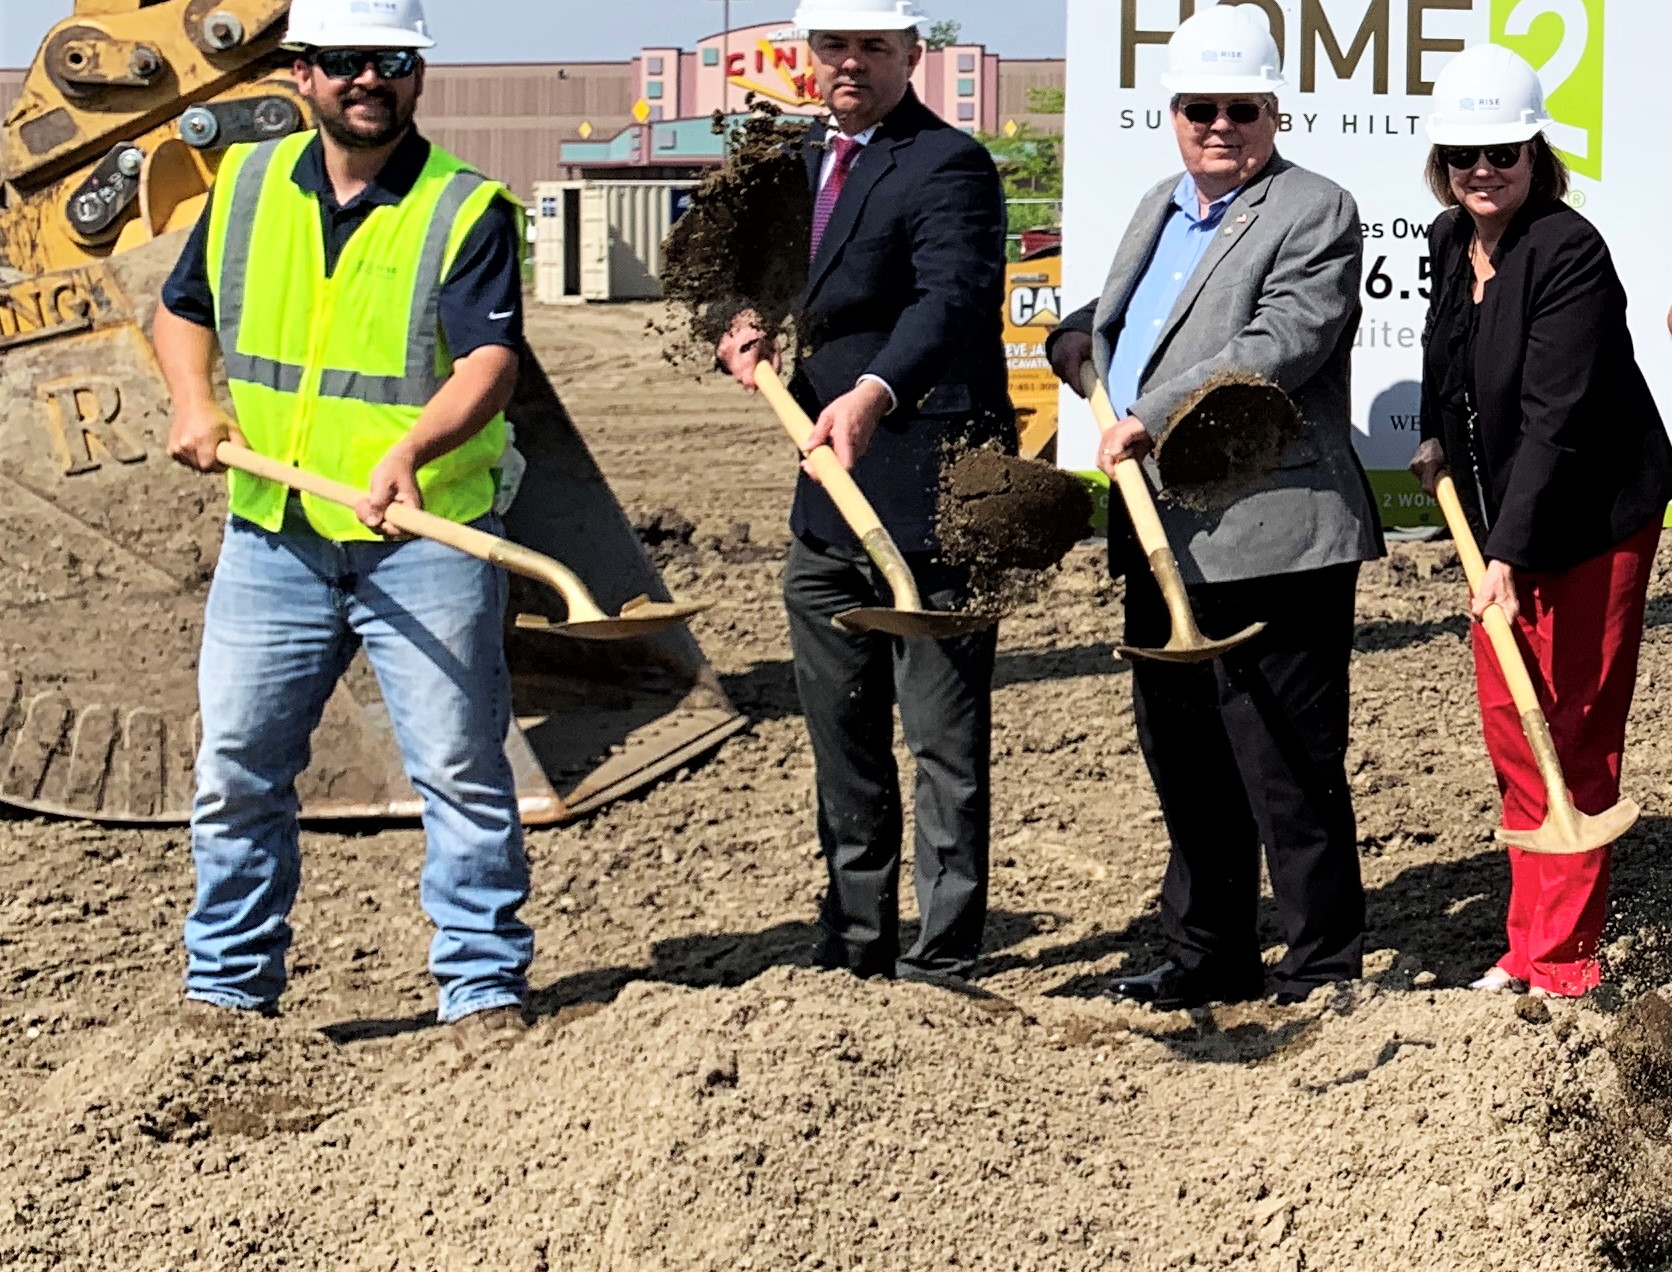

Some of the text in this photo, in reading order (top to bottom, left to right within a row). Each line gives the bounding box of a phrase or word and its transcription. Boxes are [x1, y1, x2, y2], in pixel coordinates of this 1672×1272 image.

[726, 46, 797, 77] CIN
[1220, 50, 1242, 59] RISE
[1479, 98, 1501, 106] RISE
[1278, 112, 1318, 132] BY
[1342, 114, 1420, 135] HILT
[1361, 217, 1432, 240] es Ow
[1364, 255, 1433, 300] 6.5
[1383, 493, 1437, 507] 2 WOR
